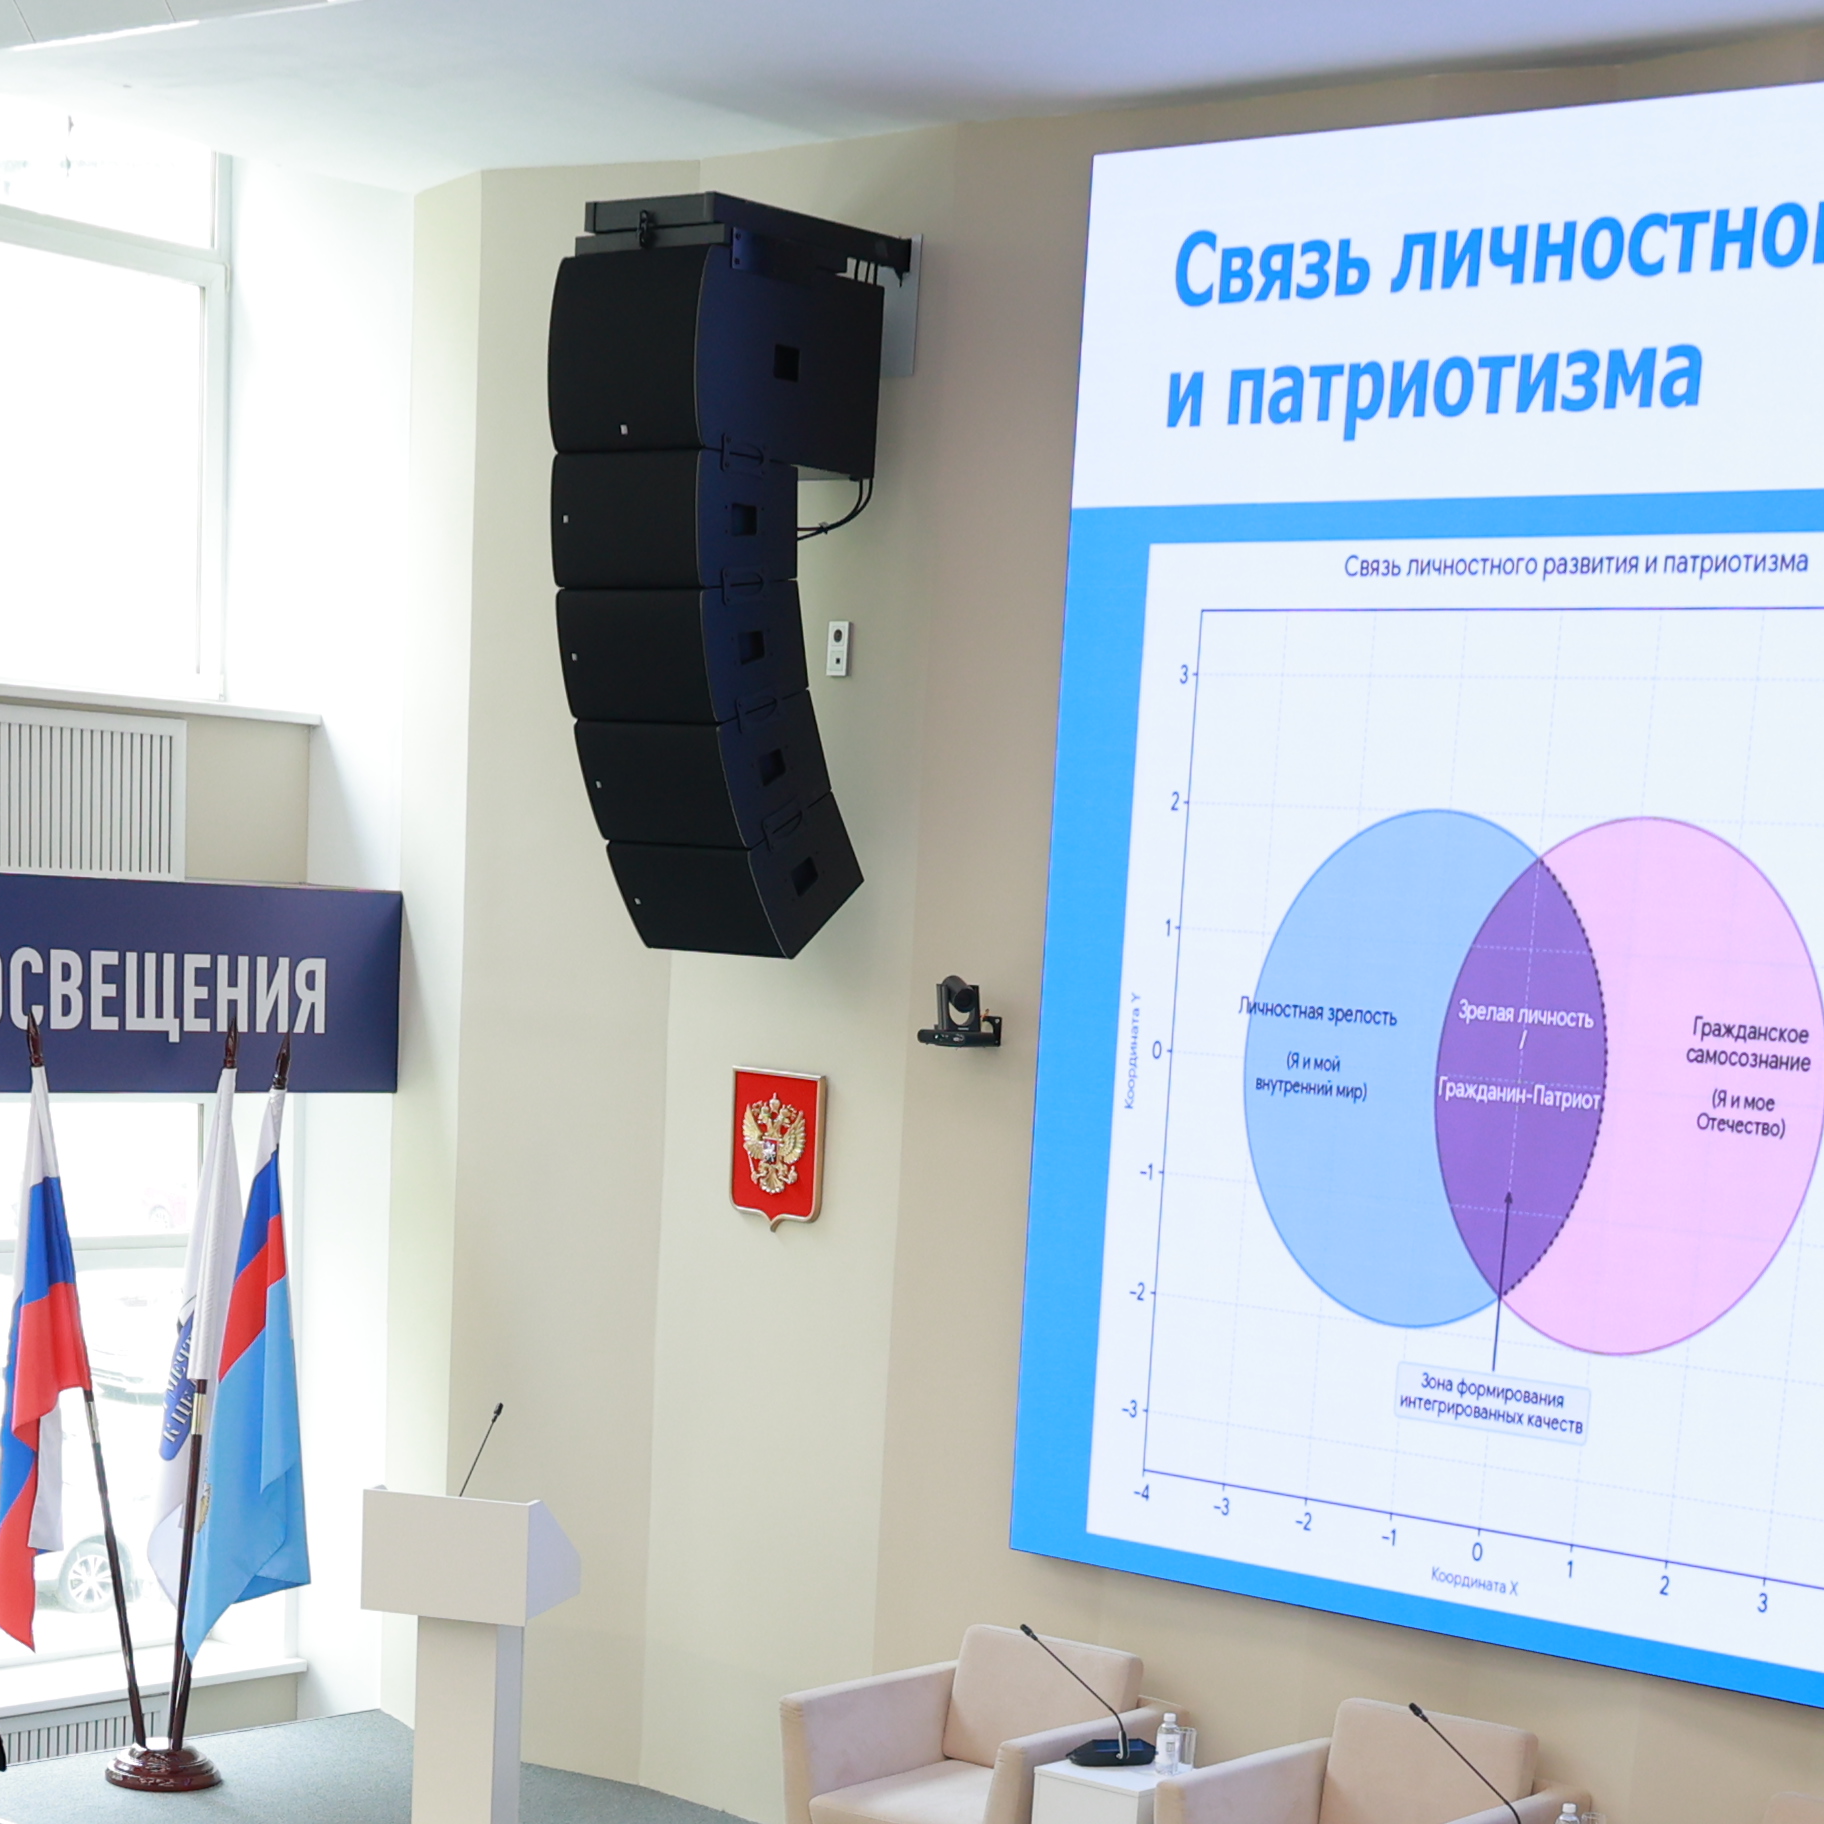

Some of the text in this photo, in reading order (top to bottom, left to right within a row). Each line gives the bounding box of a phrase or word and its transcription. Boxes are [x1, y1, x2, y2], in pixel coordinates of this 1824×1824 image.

[1176, 230, 1370, 307] Связь
[1167, 344, 1702, 441] и патриотизма
[1344, 553, 1809, 581] Связь личностного развития и патриотизма
[1179, 664, 1189, 685] 3
[1170, 791, 1180, 812] 2
[1164, 919, 1171, 937] 1
[1238, 996, 1398, 1027] Личностная зрелость
[1458, 998, 1594, 1029] Зрелая личность
[1519, 1029, 1528, 1050] /
[1693, 1015, 1810, 1044] Гражданское
[1122, 990, 1142, 1110] Координата Y
[1152, 1040, 1163, 1060] 0
[1286, 1051, 1341, 1072] (Я и мой
[1686, 1047, 1812, 1073] самосознание
[1255, 1077, 1368, 1104] внутренний мир)
[1438, 1075, 1601, 1112] Гражданин-Патриот
[1712, 1088, 1776, 1112] (Я и мое
[1696, 1112, 1786, 1140] Отечество)
[1421, 1372, 1565, 1408] Зона формирования
[1400, 1385, 1583, 1435] интегрированных качеств
[1432, 1568, 1519, 1596] Координата X
[1471, 1541, 1483, 1562] 0
[1566, 1560, 1573, 1578] 1
[1659, 1575, 1670, 1596] 2
[1757, 1592, 1768, 1613] 3
